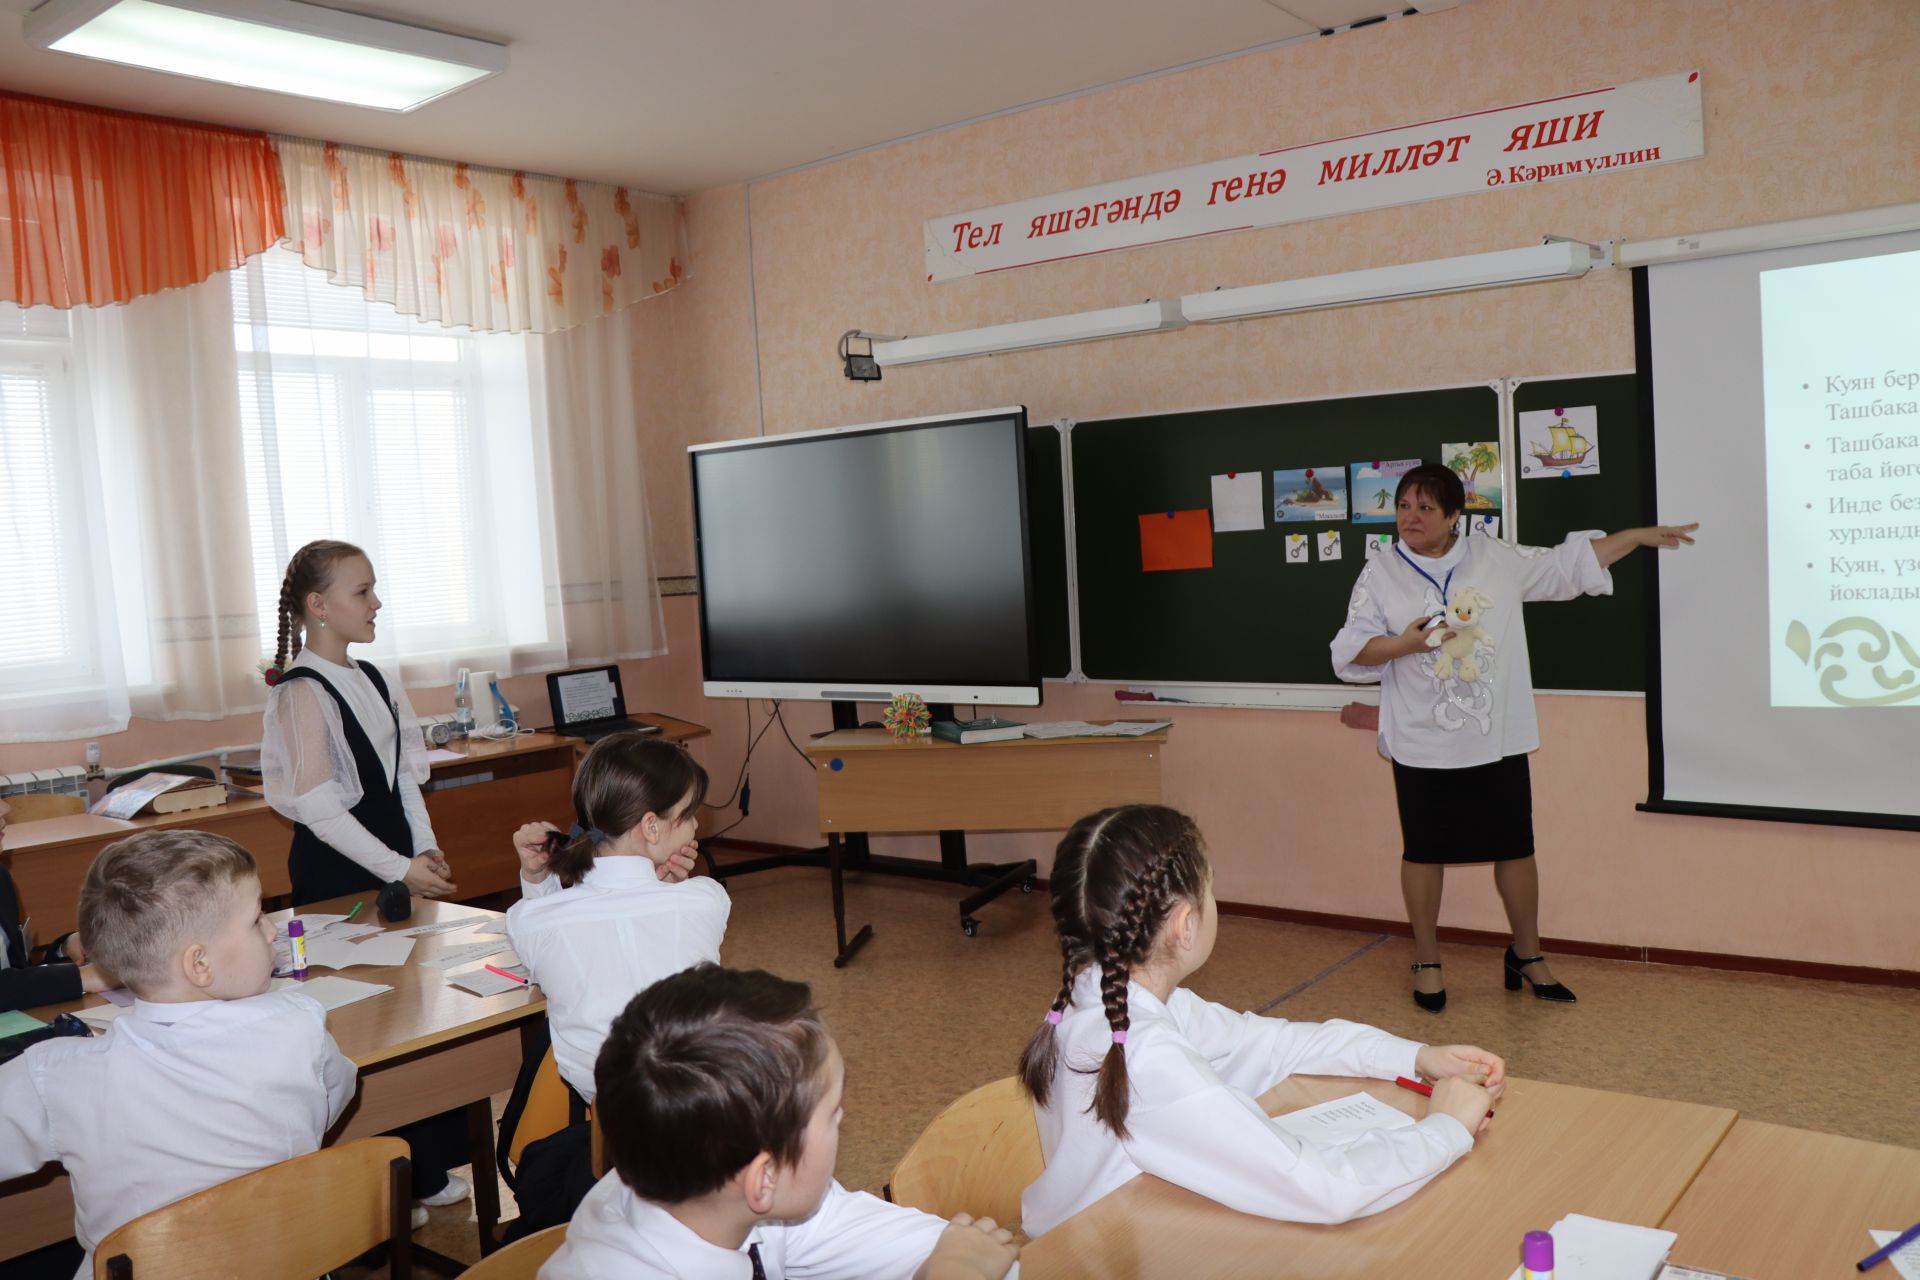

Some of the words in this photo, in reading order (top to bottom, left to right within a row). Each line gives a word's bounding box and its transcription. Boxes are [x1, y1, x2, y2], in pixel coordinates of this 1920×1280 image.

[953, 221, 1003, 252] Тел
[1026, 188, 1182, 239] яшәгәндә
[1206, 167, 1286, 206] генә
[1317, 134, 1471, 186] милләт
[1503, 110, 1605, 152] яши
[1825, 374, 1876, 396] Куян
[1826, 399, 1918, 421] Ташбака
[1826, 432, 1920, 454] Ташбака
[1827, 463, 1873, 482] таба
[1828, 496, 1883, 515] Инде
[1830, 555, 1886, 577] Куян,
